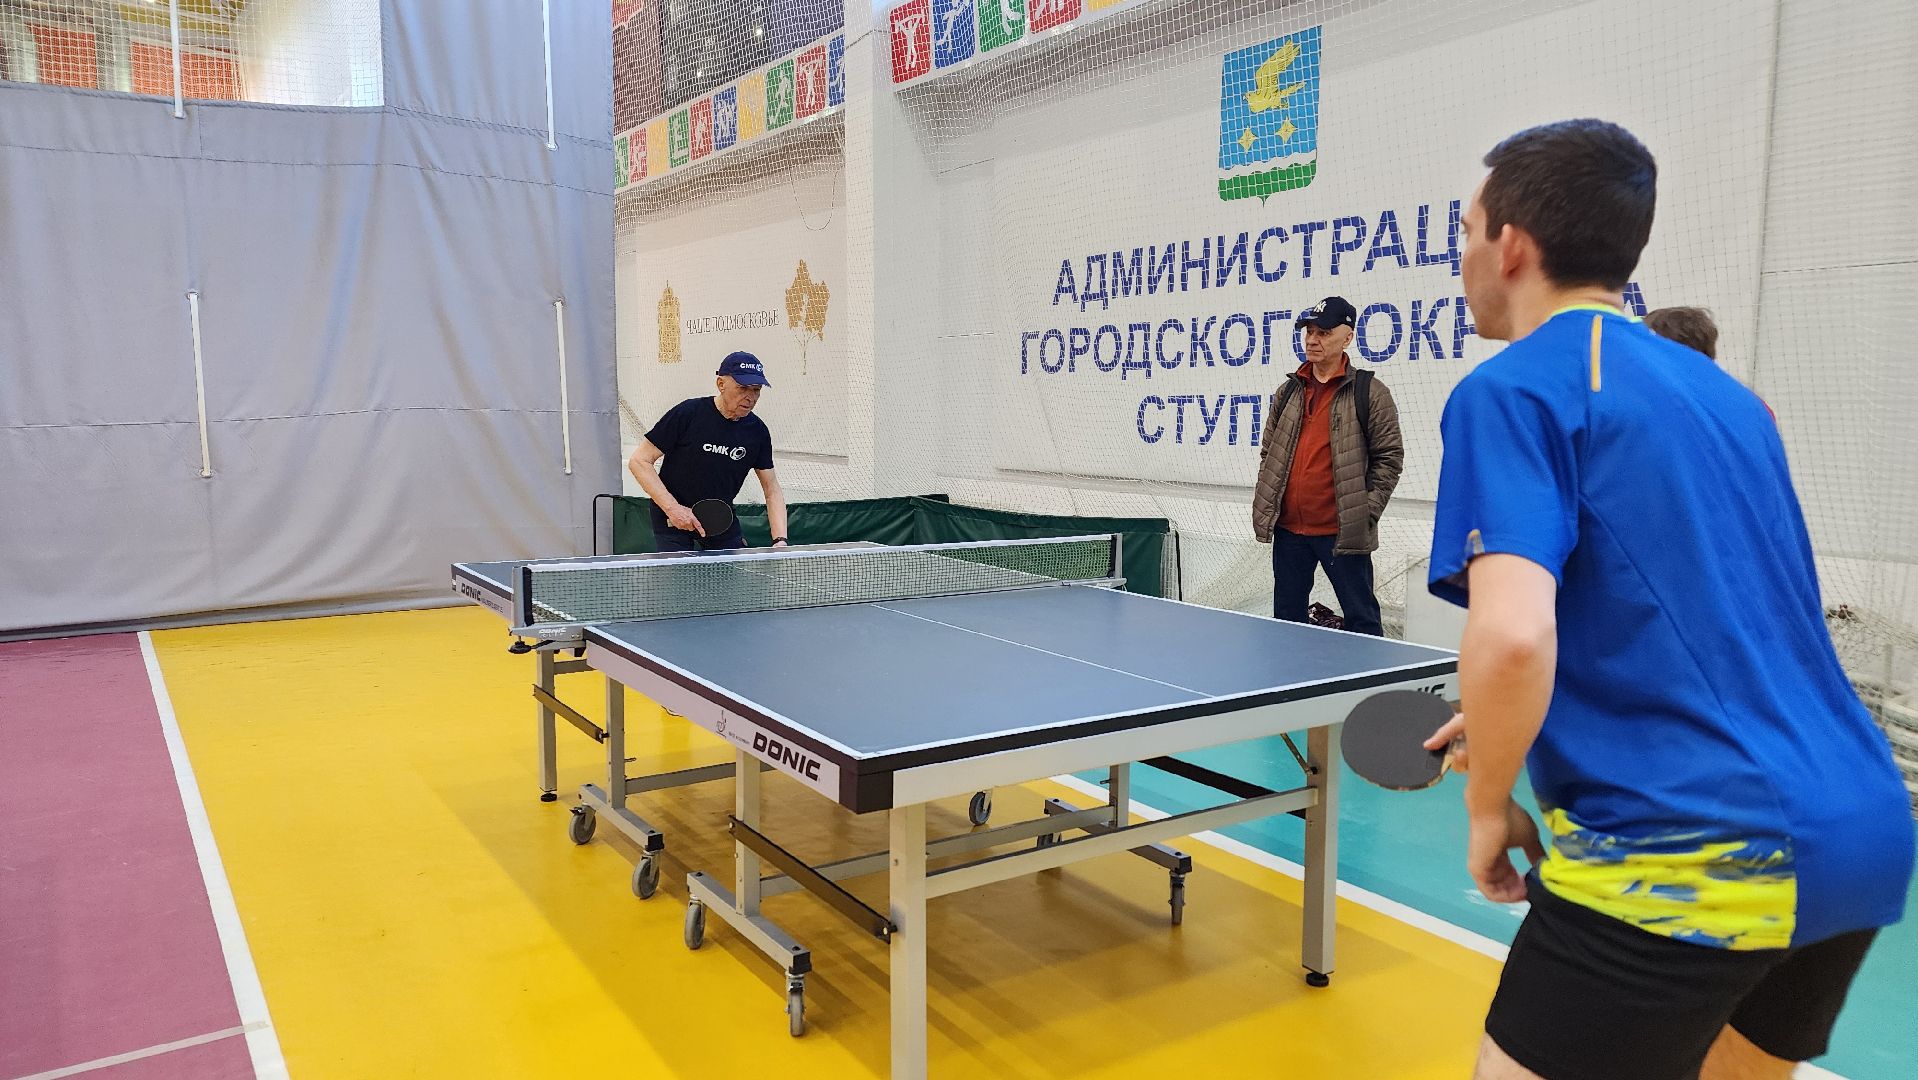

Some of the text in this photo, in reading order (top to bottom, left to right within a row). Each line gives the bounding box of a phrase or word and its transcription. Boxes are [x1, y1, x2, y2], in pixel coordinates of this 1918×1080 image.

[1053, 200, 1462, 312] АДМИНИСТРАЦ
[1137, 394, 1275, 447] СТУП
[461, 582, 481, 602] DONIC
[753, 731, 821, 782] DONIC
